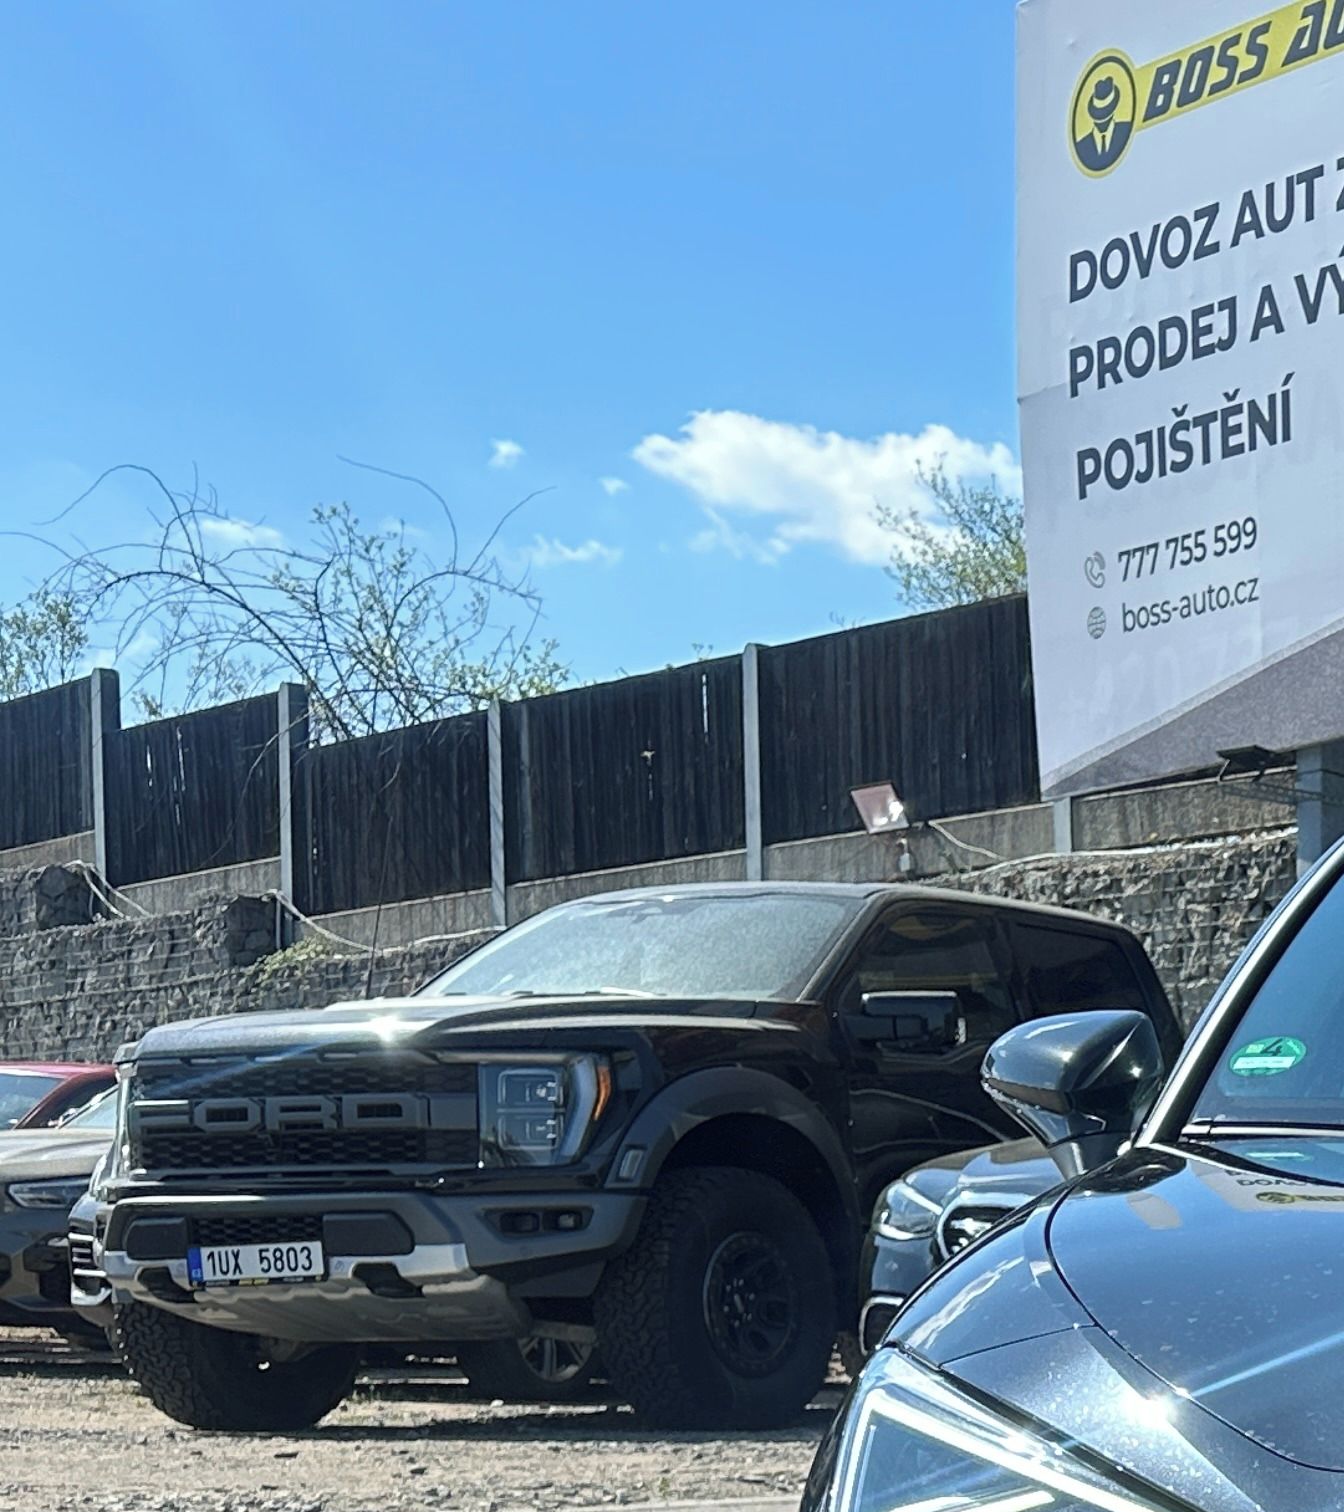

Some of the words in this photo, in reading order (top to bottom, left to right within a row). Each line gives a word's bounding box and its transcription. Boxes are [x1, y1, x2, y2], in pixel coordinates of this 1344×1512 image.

[1143, 21, 1272, 122] BOSS
[1069, 202, 1220, 303] DOVOZ
[1230, 164, 1324, 248] AUT
[1069, 296, 1238, 398] PRODEJ
[1249, 284, 1285, 342] A
[1077, 371, 1295, 500] POJIŠTĚNÍ
[1118, 542, 1160, 582] 777
[1165, 529, 1207, 570] 755
[1213, 516, 1257, 557] 599
[1122, 577, 1260, 633] boss-auto.cz
[130, 1091, 429, 1137] FORD
[207, 1249, 243, 1277] 1UX
[258, 1246, 313, 1273] 5803
